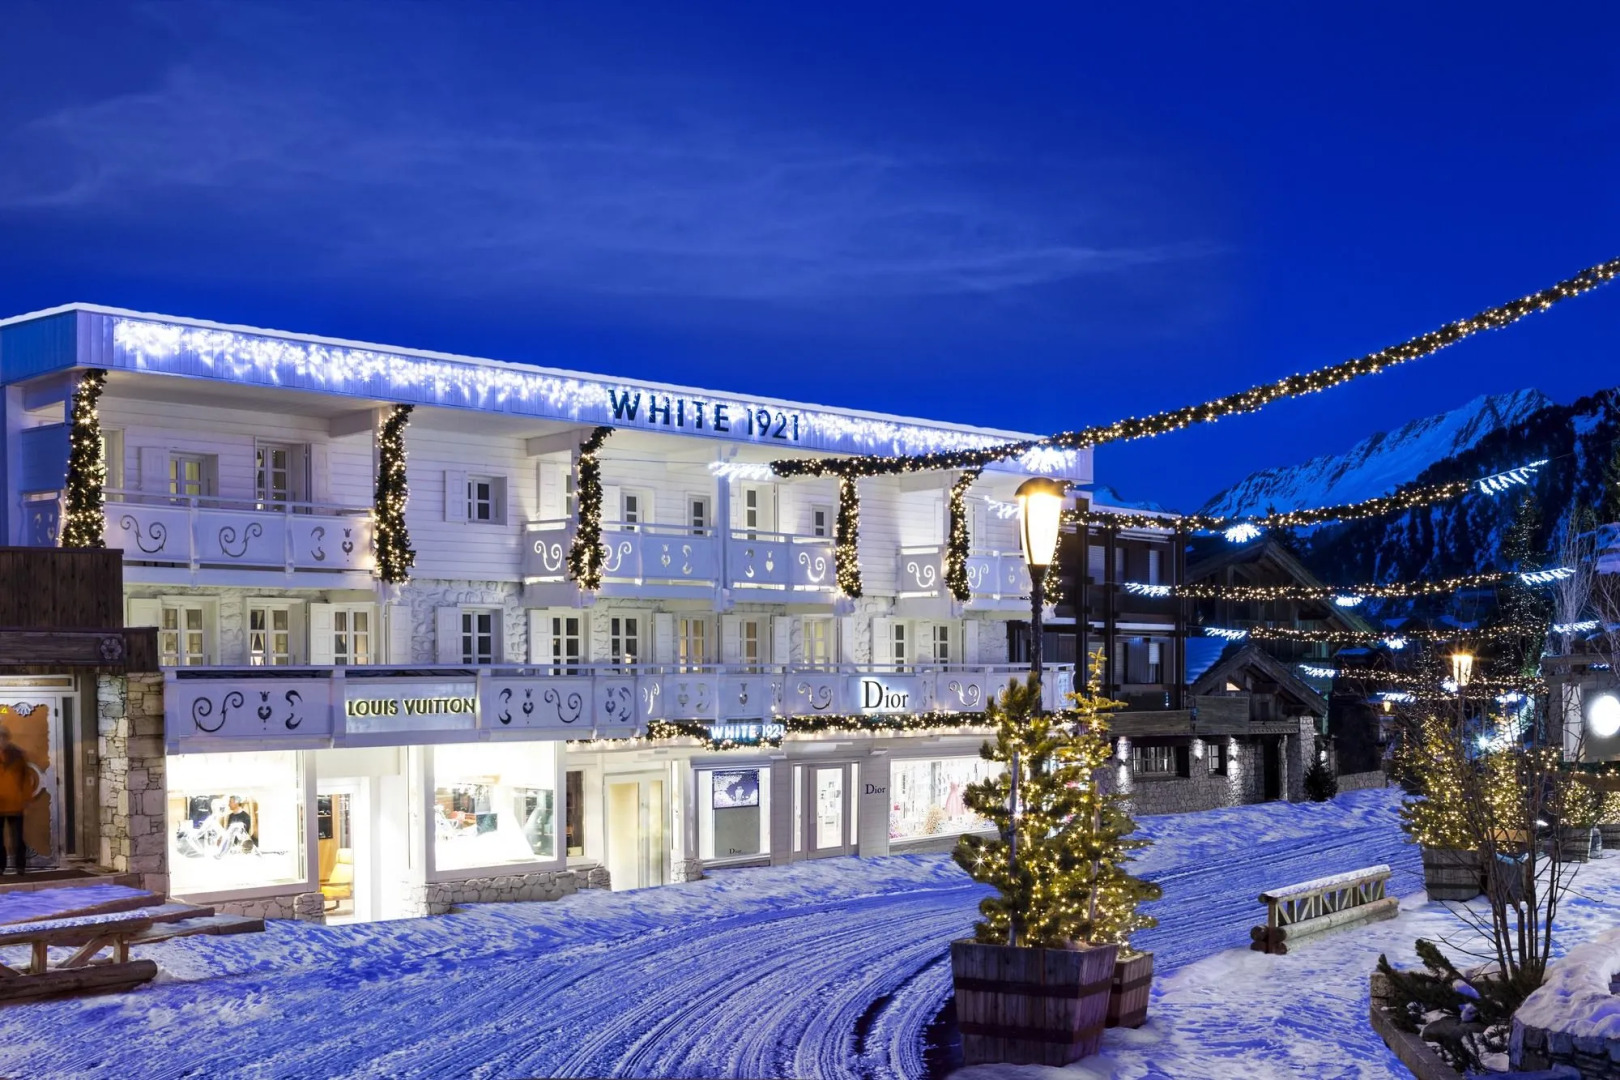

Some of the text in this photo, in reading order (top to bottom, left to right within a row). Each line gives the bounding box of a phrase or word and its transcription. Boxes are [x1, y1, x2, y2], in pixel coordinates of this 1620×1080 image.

[608, 389, 799, 440] WHITE 1921
[861, 680, 909, 708] Dior
[347, 698, 476, 716] LOUIS VUITTON
[710, 724, 784, 739] WHITE 1921
[865, 783, 886, 794] Dior
